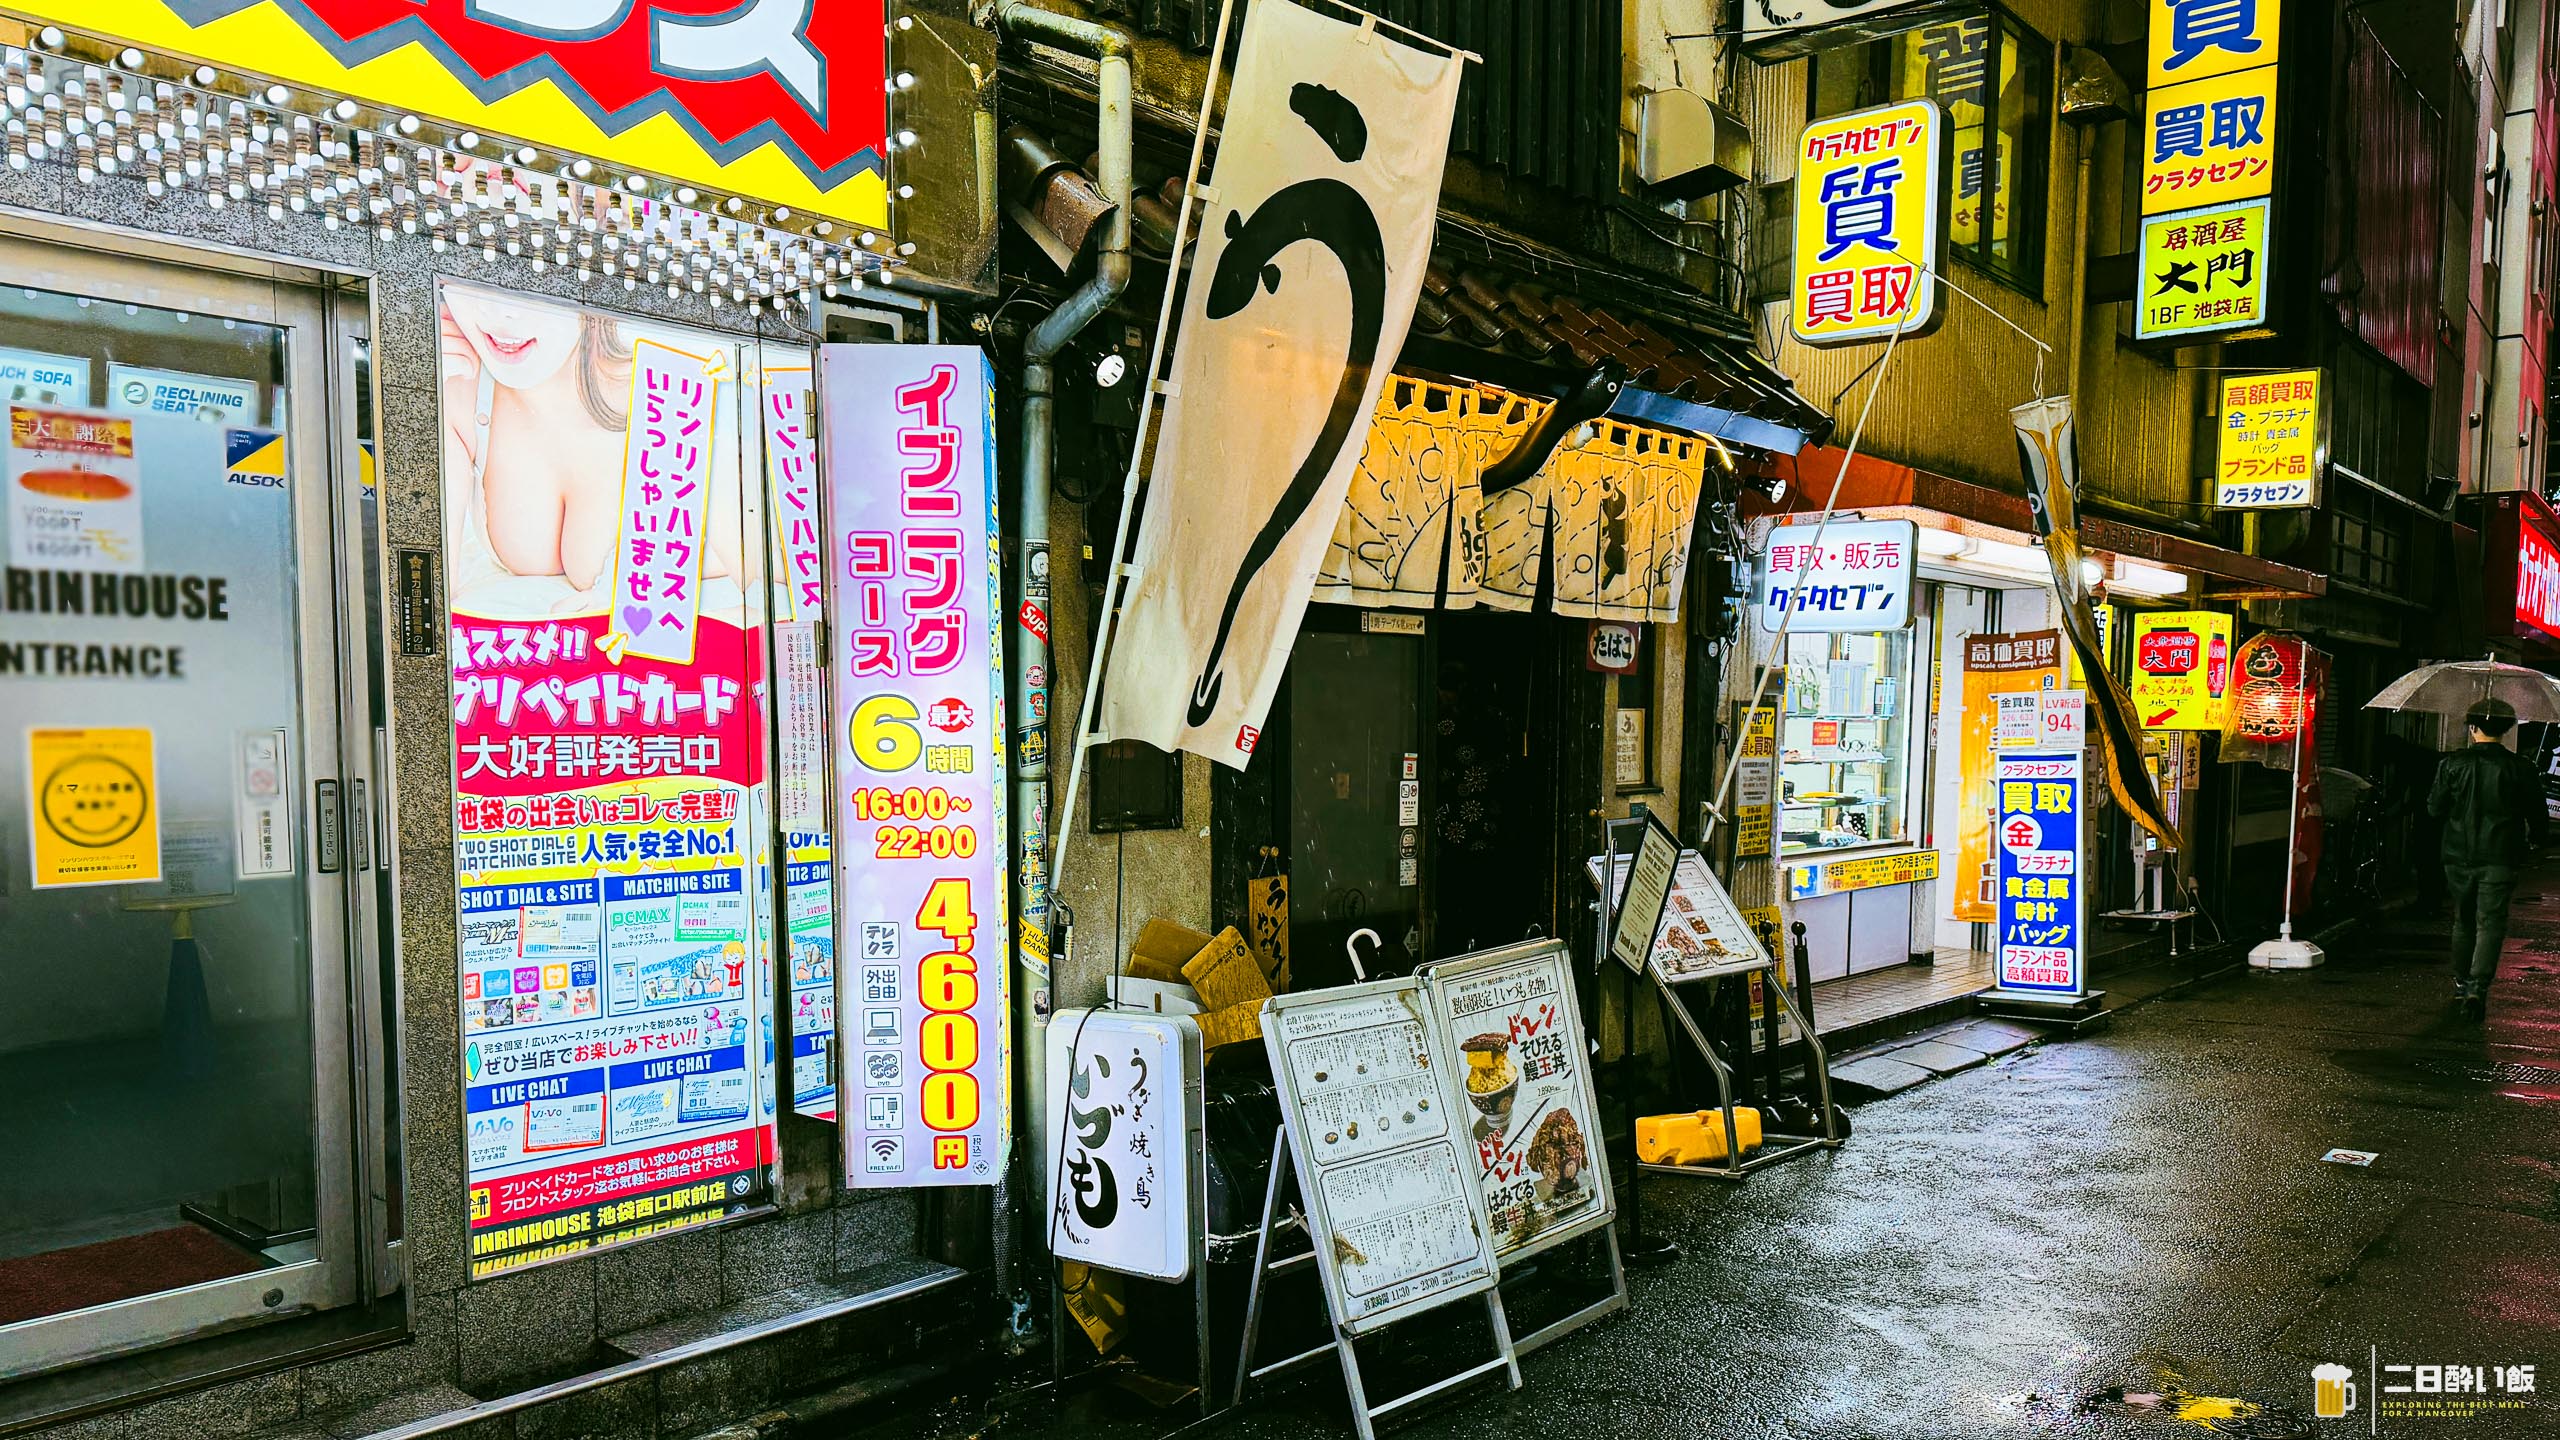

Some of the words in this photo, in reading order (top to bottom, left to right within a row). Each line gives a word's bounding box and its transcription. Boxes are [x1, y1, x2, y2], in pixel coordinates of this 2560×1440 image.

[1807, 119, 1925, 161] クラタセブン
[2153, 96, 2265, 165] 買取
[2147, 156, 2268, 195] クラタセブン
[1818, 159, 1902, 262] 質
[2162, 217, 2246, 252] 居酒屋
[2149, 248, 2255, 298] 大門
[1806, 265, 1914, 328] 買取
[2149, 304, 2185, 325] 1BF
[2194, 296, 2252, 320] 池袋店
[33, 369, 73, 386] SOFA
[152, 399, 199, 414] SEAT
[155, 385, 243, 408] RECLINING
[2227, 381, 2314, 407] 高額買取
[2228, 408, 2311, 429] 金・プラチナ
[2237, 430, 2260, 442] 時計
[2266, 427, 2300, 440] 貴金属
[2252, 442, 2281, 454] バッグ
[2225, 455, 2306, 478] ブランド品
[227, 473, 285, 489] ALSOK
[626, 366, 671, 603] いらっしゃいませ
[2224, 483, 2304, 504] クラタセブン
[658, 377, 702, 632] リンリンハウスへ
[897, 366, 965, 675] イブニング
[1771, 540, 1901, 573] 買取・販売
[850, 532, 898, 677] コース
[1768, 583, 1895, 613] クラタセブン
[452, 621, 589, 671] オススメ!!
[1593, 631, 1632, 660] たばこ
[1971, 638, 2055, 663] 高価買取
[2142, 650, 2192, 668] 大門
[1971, 662, 1997, 670] upscale
[2038, 658, 2054, 668] shop
[453, 671, 741, 727] プリペイドカード
[2001, 697, 2035, 708] 金買取
[2045, 699, 2082, 709] LV新品
[2148, 699, 2188, 707] 地下
[848, 693, 923, 772] 6
[927, 702, 974, 730] 最大
[2047, 713, 2081, 732] 94%
[461, 735, 722, 779] 大好評発売中
[926, 745, 974, 774] 時間
[2002, 763, 2074, 778] クラタセブン
[457, 790, 738, 832] 池袋の出会いはコレで完璧!!
[2002, 782, 2073, 814] 買取
[490, 838, 528, 853] SHOT
[532, 836, 564, 851] DIAL
[580, 827, 735, 863] 人気・安全No.1
[875, 825, 978, 859] 22:00
[2006, 819, 2034, 847] 金
[542, 852, 577, 866] SITE
[2020, 855, 2073, 870] プラチナ
[461, 889, 504, 910] SHOT
[508, 886, 544, 905] DIAL
[546, 888, 558, 903] &
[560, 882, 593, 901] SITE
[623, 875, 699, 897] MATCHING
[702, 873, 731, 890] SITE
[2006, 878, 2070, 898] 貴金属
[611, 908, 670, 930] PCMAX
[2015, 902, 2058, 922] 時計
[866, 925, 895, 939] テレ
[2007, 923, 2072, 945] バッグ
[867, 940, 895, 956] クラ
[2006, 948, 2068, 966] ブランド品
[866, 969, 896, 984] 外出
[2006, 966, 2070, 983] 高額買取
[868, 984, 896, 999] 自由
[915, 877, 981, 1170] 4,600円
[484, 1028, 699, 1076] ぜひ当店でお楽しみ下さい!!
[1520, 1032, 1562, 1060] そびえる
[644, 1061, 674, 1080] LIVE
[675, 1053, 713, 1074] CHAT
[1523, 1052, 1567, 1083] 鰻玉丼
[491, 1083, 526, 1105] LIVE
[528, 1077, 569, 1099] CHAT
[1064, 1044, 1126, 1230] いづも
[500, 1138, 739, 1199] プリペイドカードをお買い求めのお客様は
[501, 1154, 740, 1214] フロントスタッフ迄お気軽にお問合せ下さい。
[1487, 1179, 1535, 1213] はみでる
[597, 1181, 726, 1227] 池袋西口駅前店
[1363, 1291, 1390, 1311] 営業時間
[1391, 1285, 1411, 1302] 11:30
[1419, 1276, 1440, 1292] 23:00
